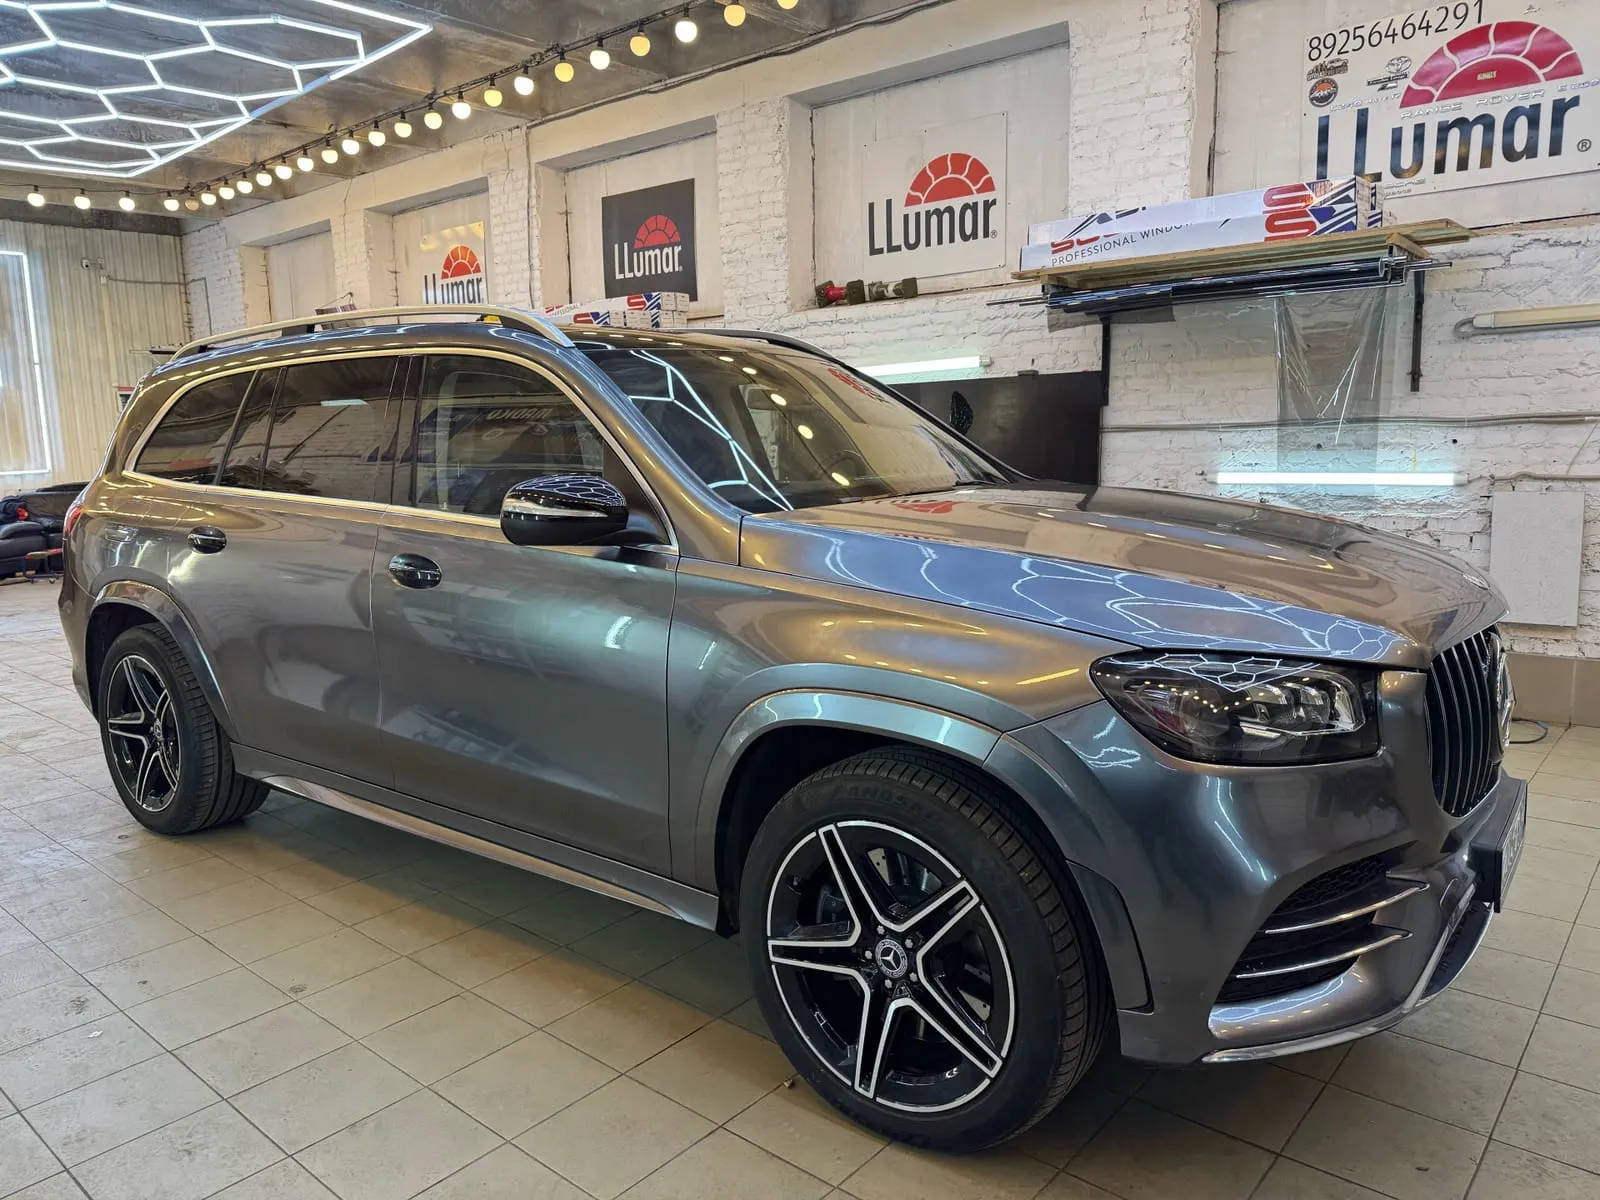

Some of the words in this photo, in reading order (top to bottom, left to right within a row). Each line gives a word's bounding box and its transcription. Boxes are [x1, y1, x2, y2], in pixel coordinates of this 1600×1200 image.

[1307, 0, 1483, 61] 89256464291
[1475, 89, 1545, 109] ROVER
[1316, 95, 1581, 183] LLumar
[868, 198, 997, 256] LLumar
[1052, 234, 1136, 266] PROFESSIONAL
[1140, 223, 1192, 239] WIND
[614, 241, 682, 279] LLumar
